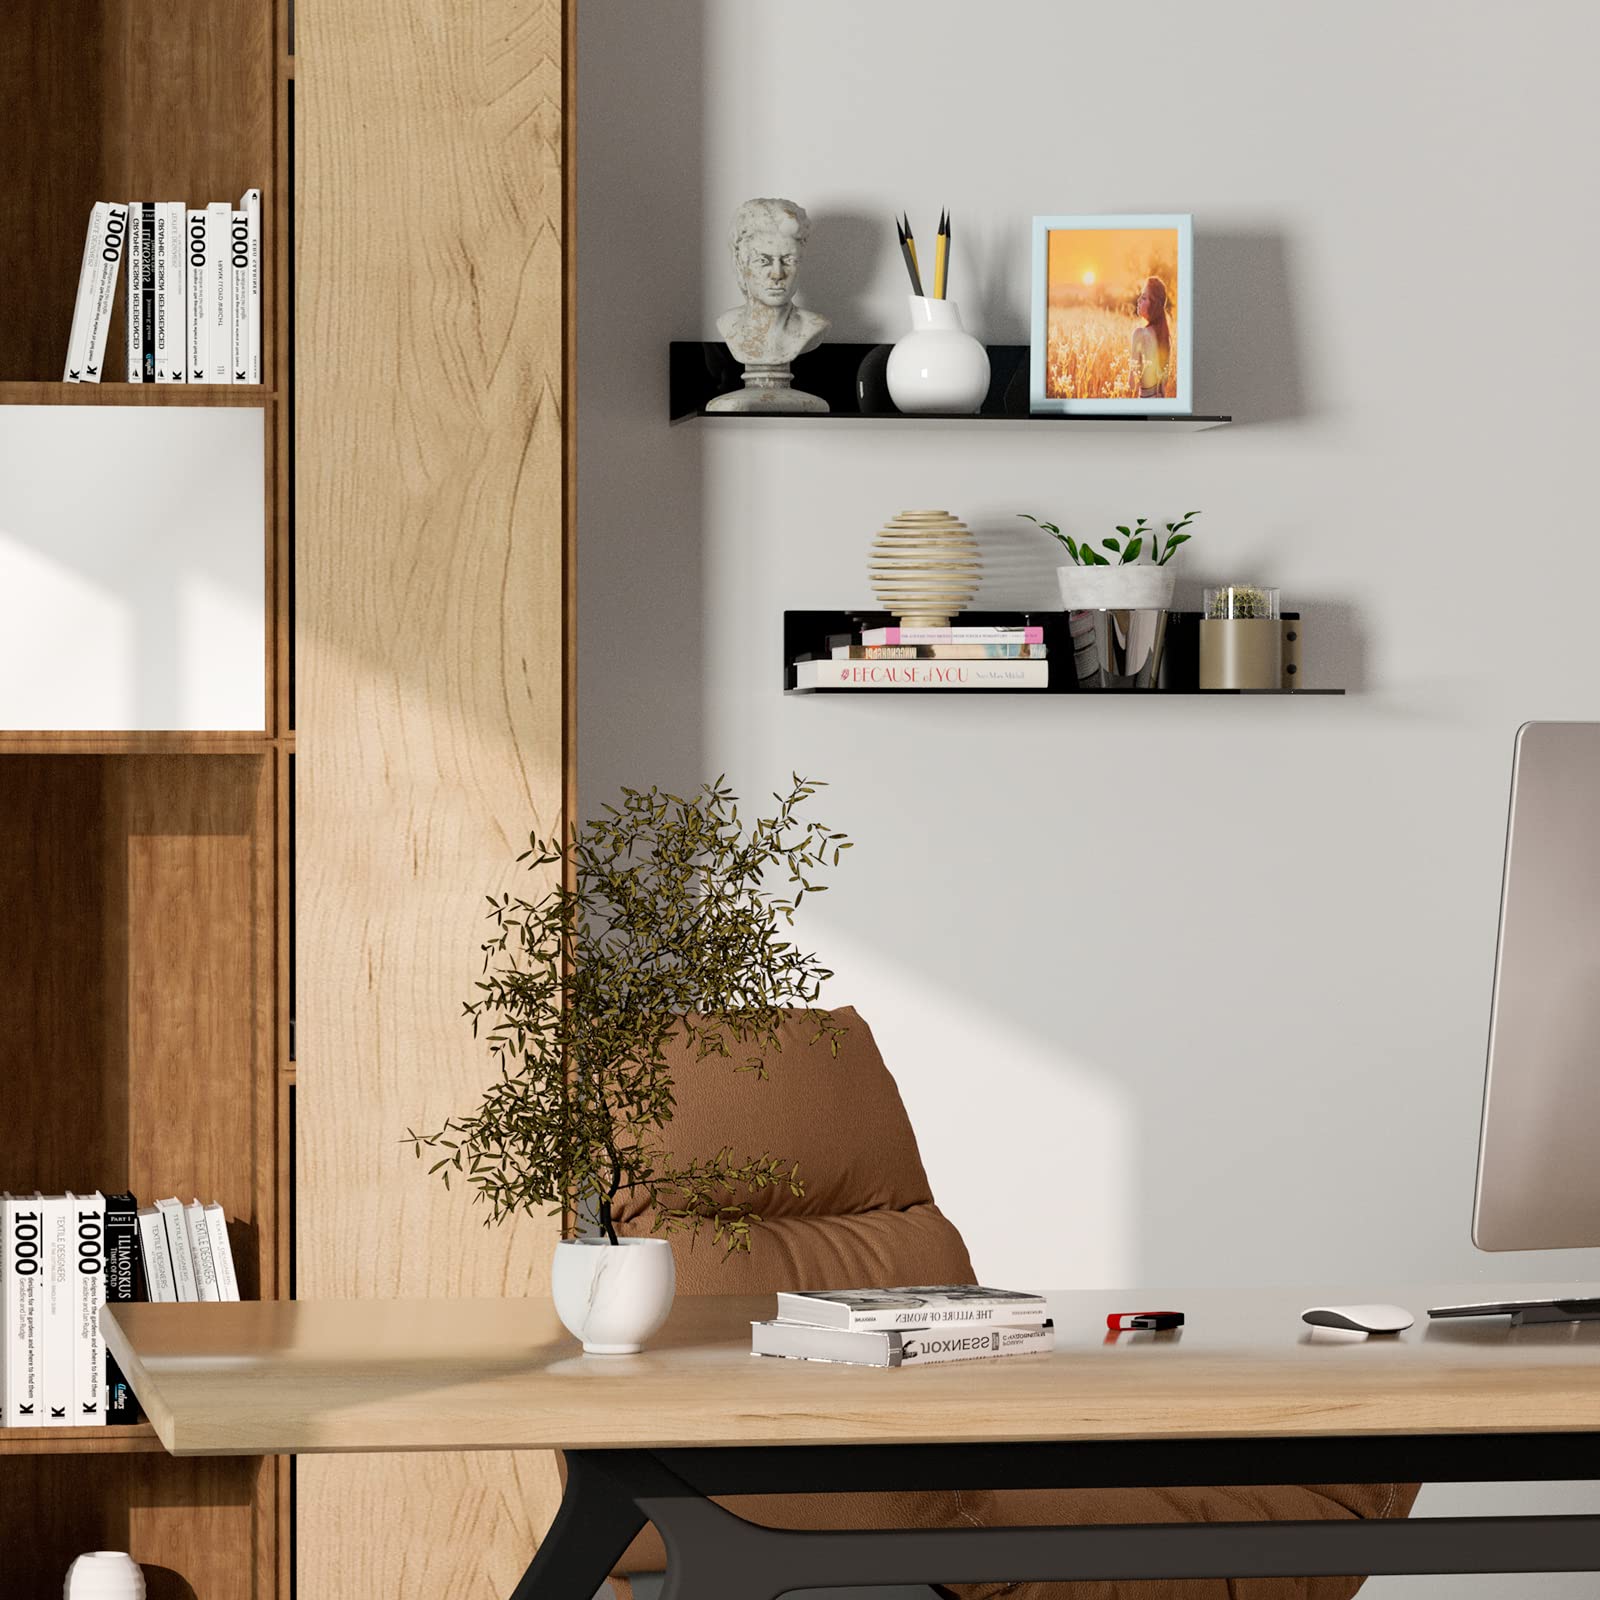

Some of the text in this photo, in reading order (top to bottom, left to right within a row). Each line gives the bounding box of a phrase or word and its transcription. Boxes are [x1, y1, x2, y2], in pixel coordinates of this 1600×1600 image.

[936, 667, 968, 682] YOU
[15, 1211, 37, 1275] 1000
[57, 1216, 65, 1282] TEXTILE DESIGNERS
[79, 1211, 101, 1274] 1000
[195, 1219, 209, 1245] TEXTILE
[119, 1235, 131, 1298] ILIMOSKUS
[152, 1225, 161, 1250] TEXTILE
[157, 1252, 167, 1289] DESIGNERS
[201, 1247, 214, 1284] DESIGNERS
[20, 1404, 33, 1414] K
[51, 1407, 65, 1417] K
[83, 1402, 97, 1413] K
